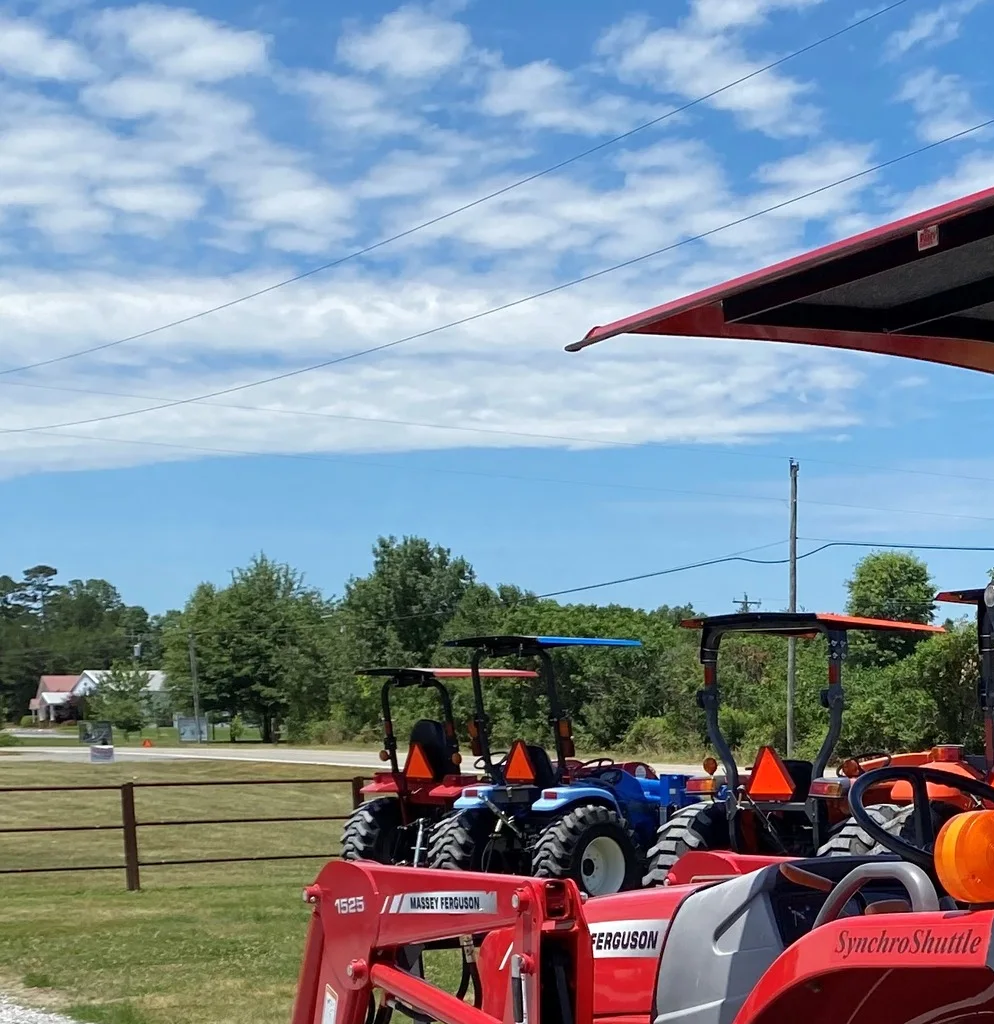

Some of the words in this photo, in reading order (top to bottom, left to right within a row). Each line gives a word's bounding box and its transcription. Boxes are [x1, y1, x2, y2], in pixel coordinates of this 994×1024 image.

[334, 896, 365, 914] 1525
[410, 897, 438, 910] MASSEY
[440, 896, 480, 910] FERGUSON
[591, 930, 659, 950] FERGUSON
[835, 928, 982, 959] SynchroShuttle
